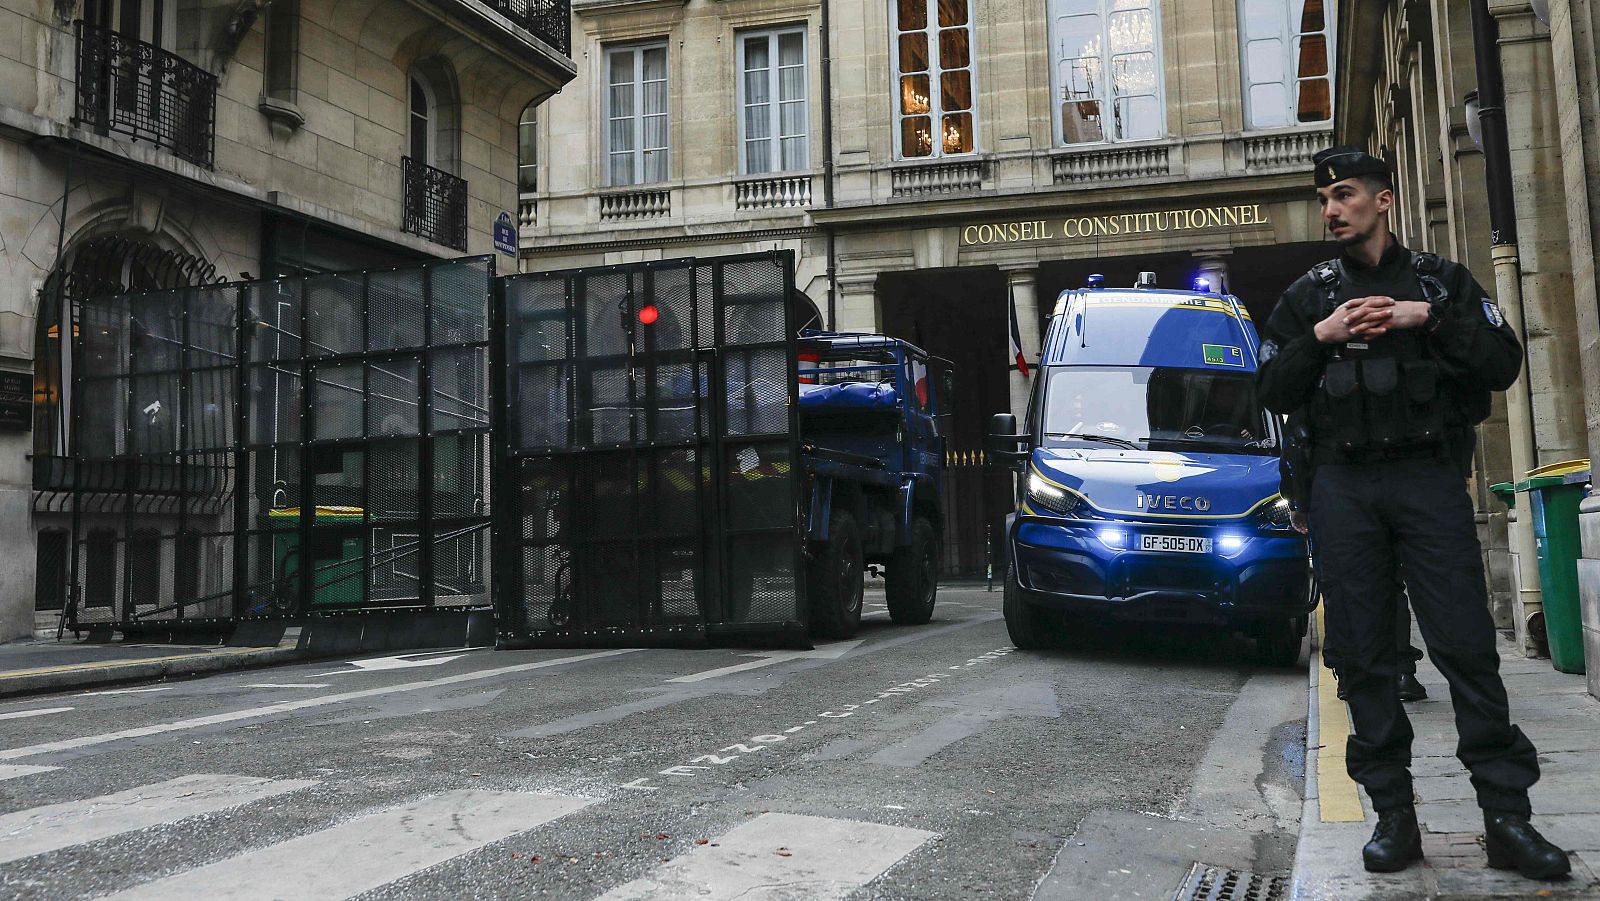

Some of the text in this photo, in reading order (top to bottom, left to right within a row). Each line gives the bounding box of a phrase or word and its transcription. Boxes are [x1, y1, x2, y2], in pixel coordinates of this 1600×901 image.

[963, 204, 1268, 245] CONSEIL CONSTITUTIONNEL
[1100, 296, 1204, 307] GENDARMERIE
[1231, 348, 1240, 357] E
[1136, 494, 1211, 512] IVECO
[1143, 536, 1204, 552] GF-505-DX
